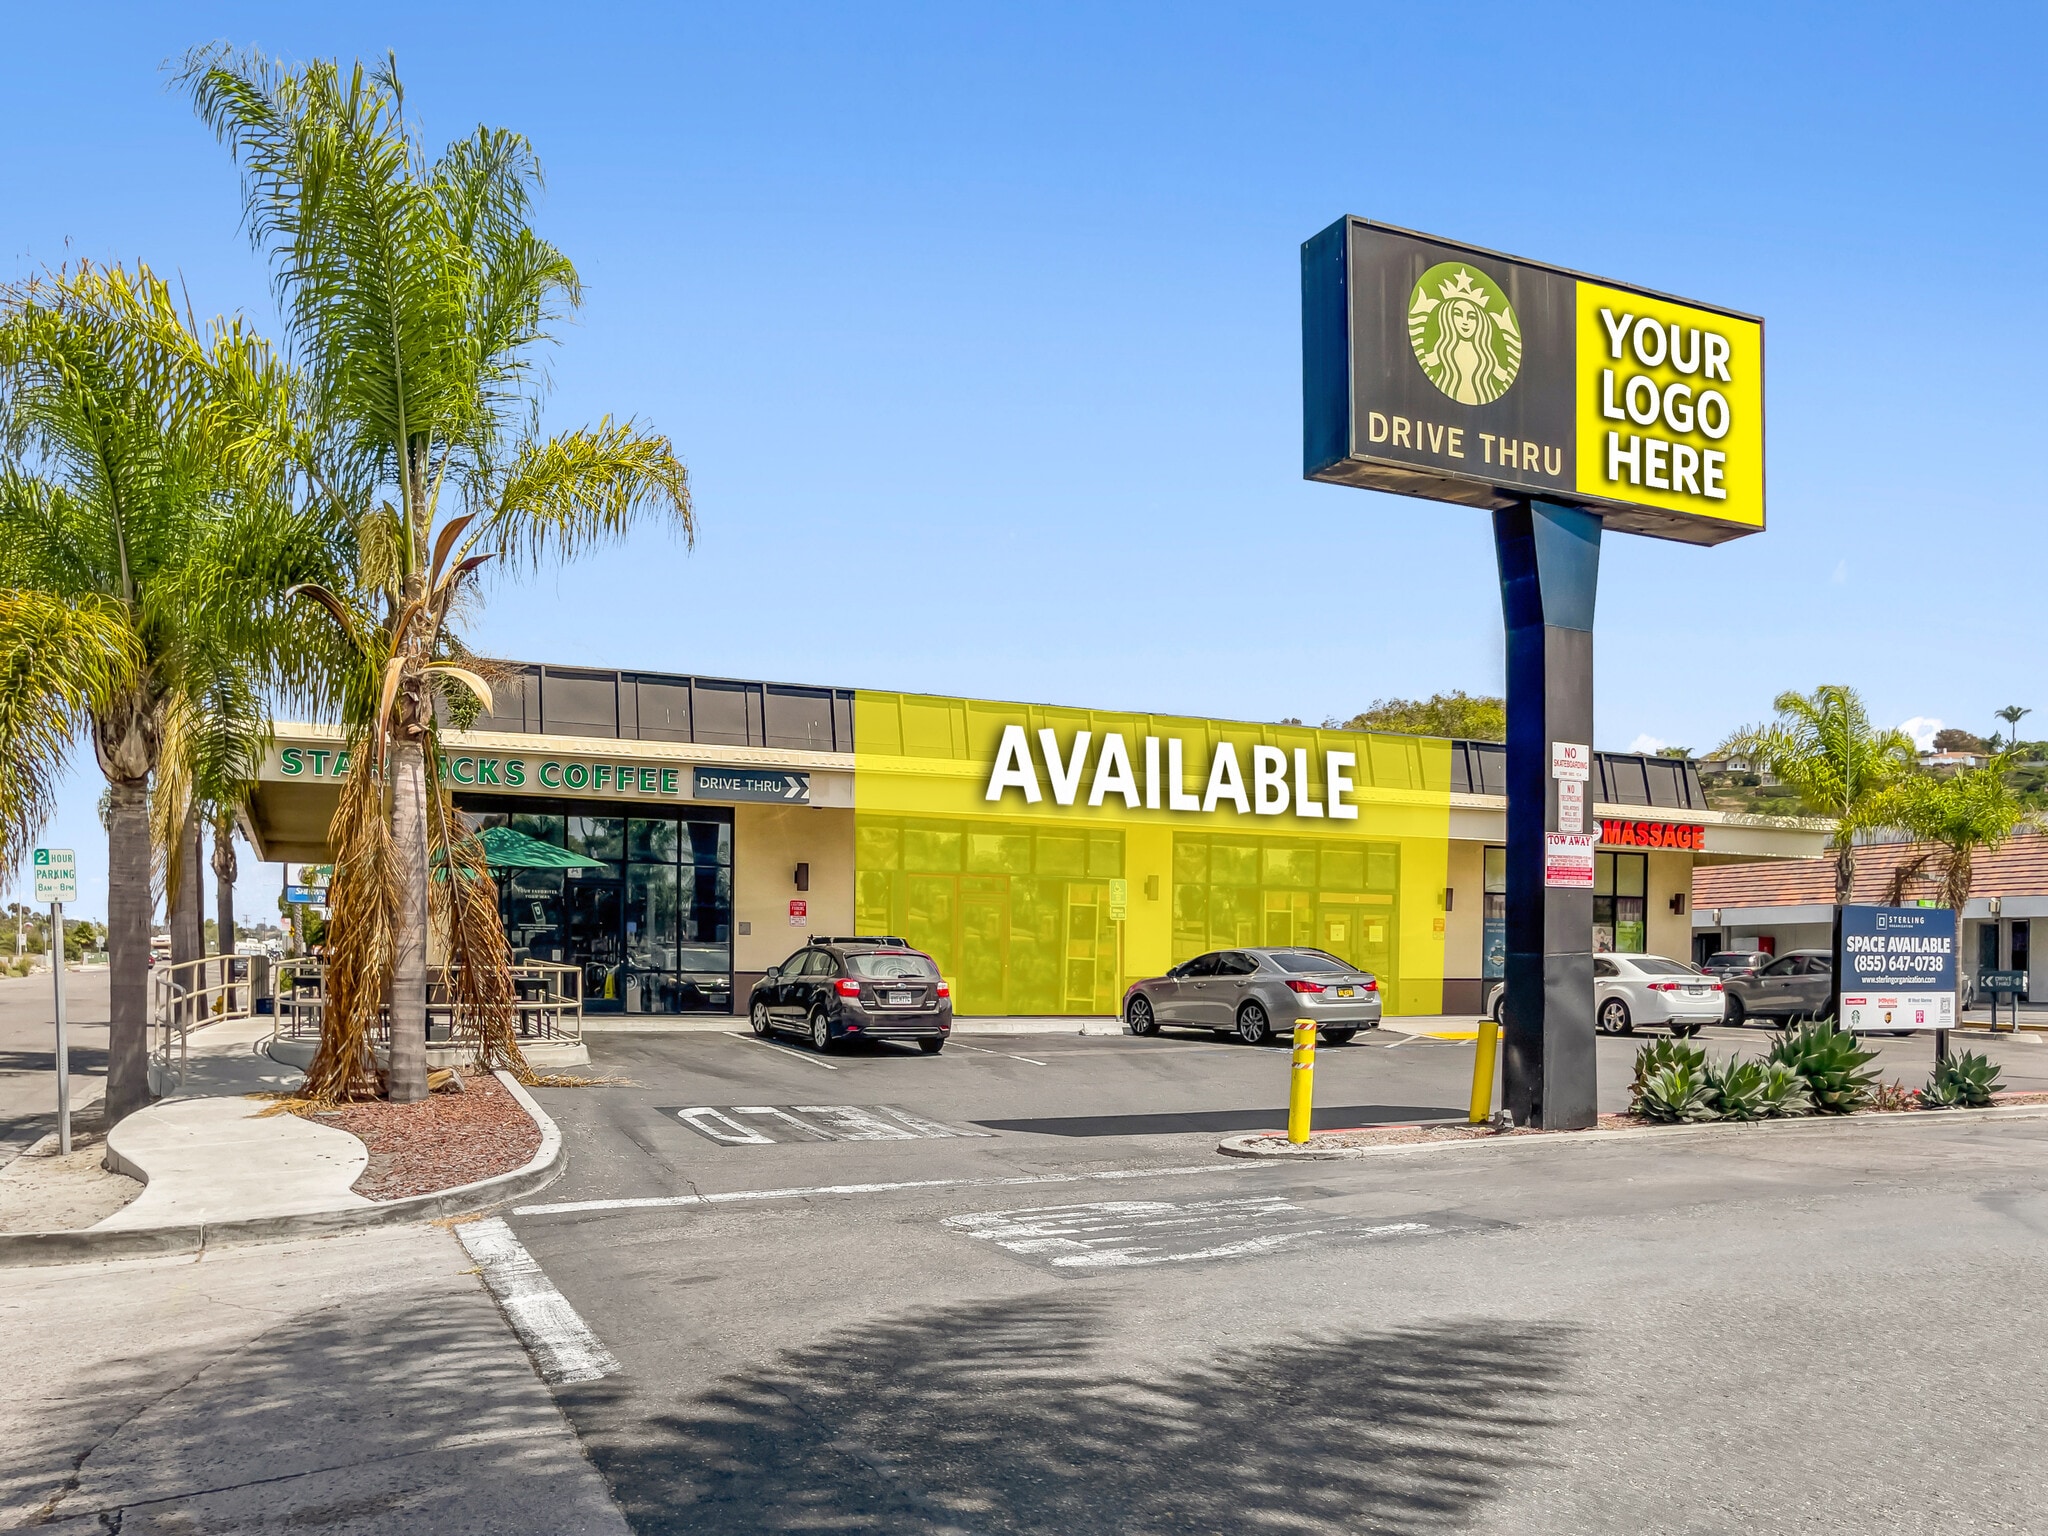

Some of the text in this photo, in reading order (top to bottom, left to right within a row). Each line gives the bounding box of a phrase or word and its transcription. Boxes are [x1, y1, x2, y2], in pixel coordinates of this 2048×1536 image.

[1368, 412, 1562, 476] DRIVE THRU
[1564, 747, 1577, 759] NO
[280, 747, 680, 794] STACKS COFFEE
[700, 776, 782, 793] DRIVE THRU
[1567, 785, 1575, 794] NO
[1602, 819, 1705, 850] MASSAGE
[1547, 835, 1591, 847] TOW AWAY
[36, 851, 73, 863] 2 HOUR
[36, 869, 75, 879] PARKING
[38, 883, 52, 891] 8AM
[60, 882, 74, 891] 8PM
[1889, 916, 1925, 924] STERLING
[1846, 936, 1951, 953] SPACE AVAILABLE
[1854, 955, 1943, 973] (855) 647-0738
[1861, 975, 1936, 985] www.sterlingorganization.com
